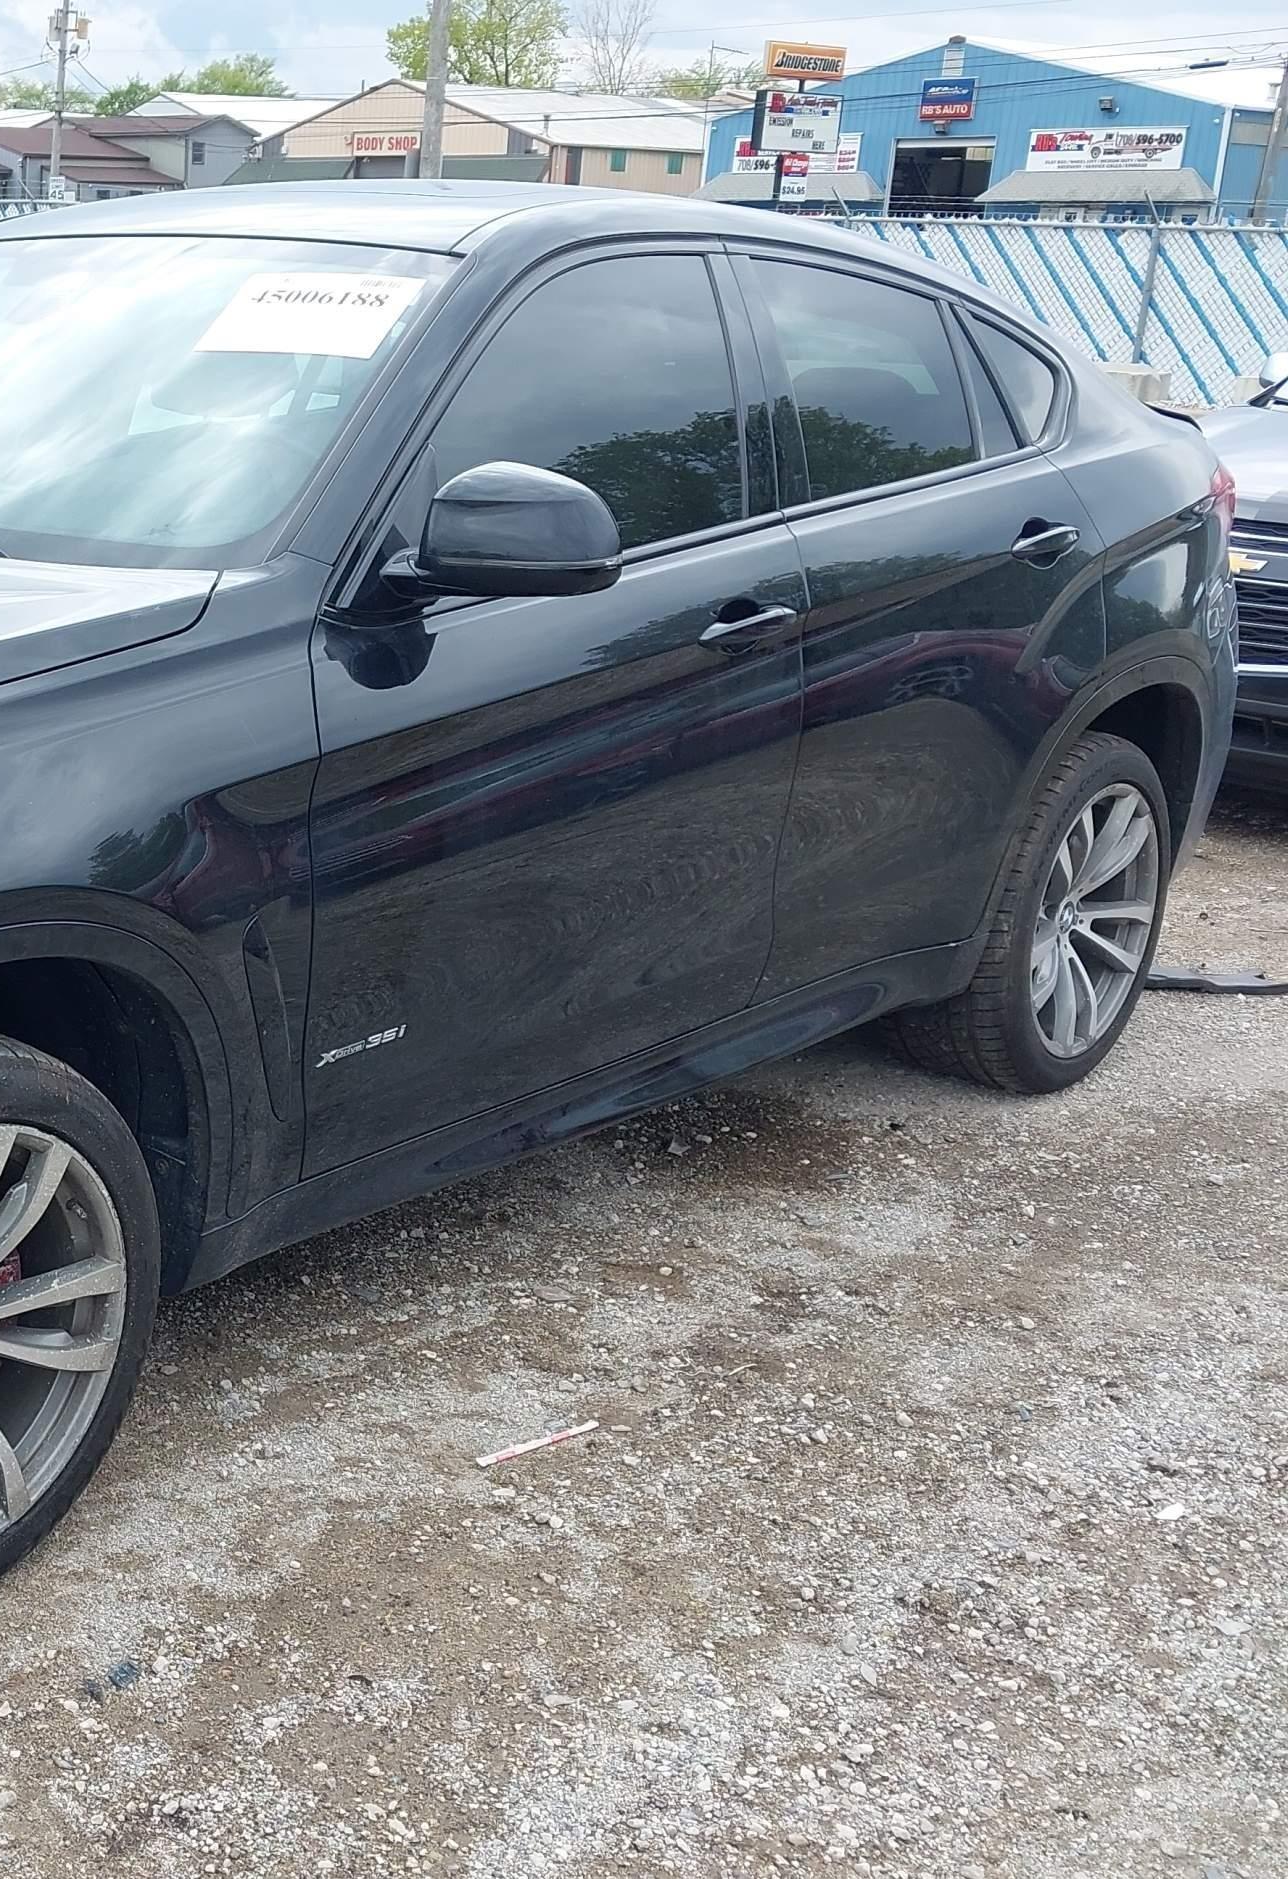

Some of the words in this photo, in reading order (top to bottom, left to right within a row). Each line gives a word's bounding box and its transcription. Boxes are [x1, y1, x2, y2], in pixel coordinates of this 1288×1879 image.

[774, 50, 842, 73] BRIDGESTONE
[943, 104, 968, 114] AUTO
[356, 137, 385, 151] BODY
[387, 136, 418, 151] SHOP
[50, 190, 64, 200] 45
[782, 186, 805, 195] $24.95
